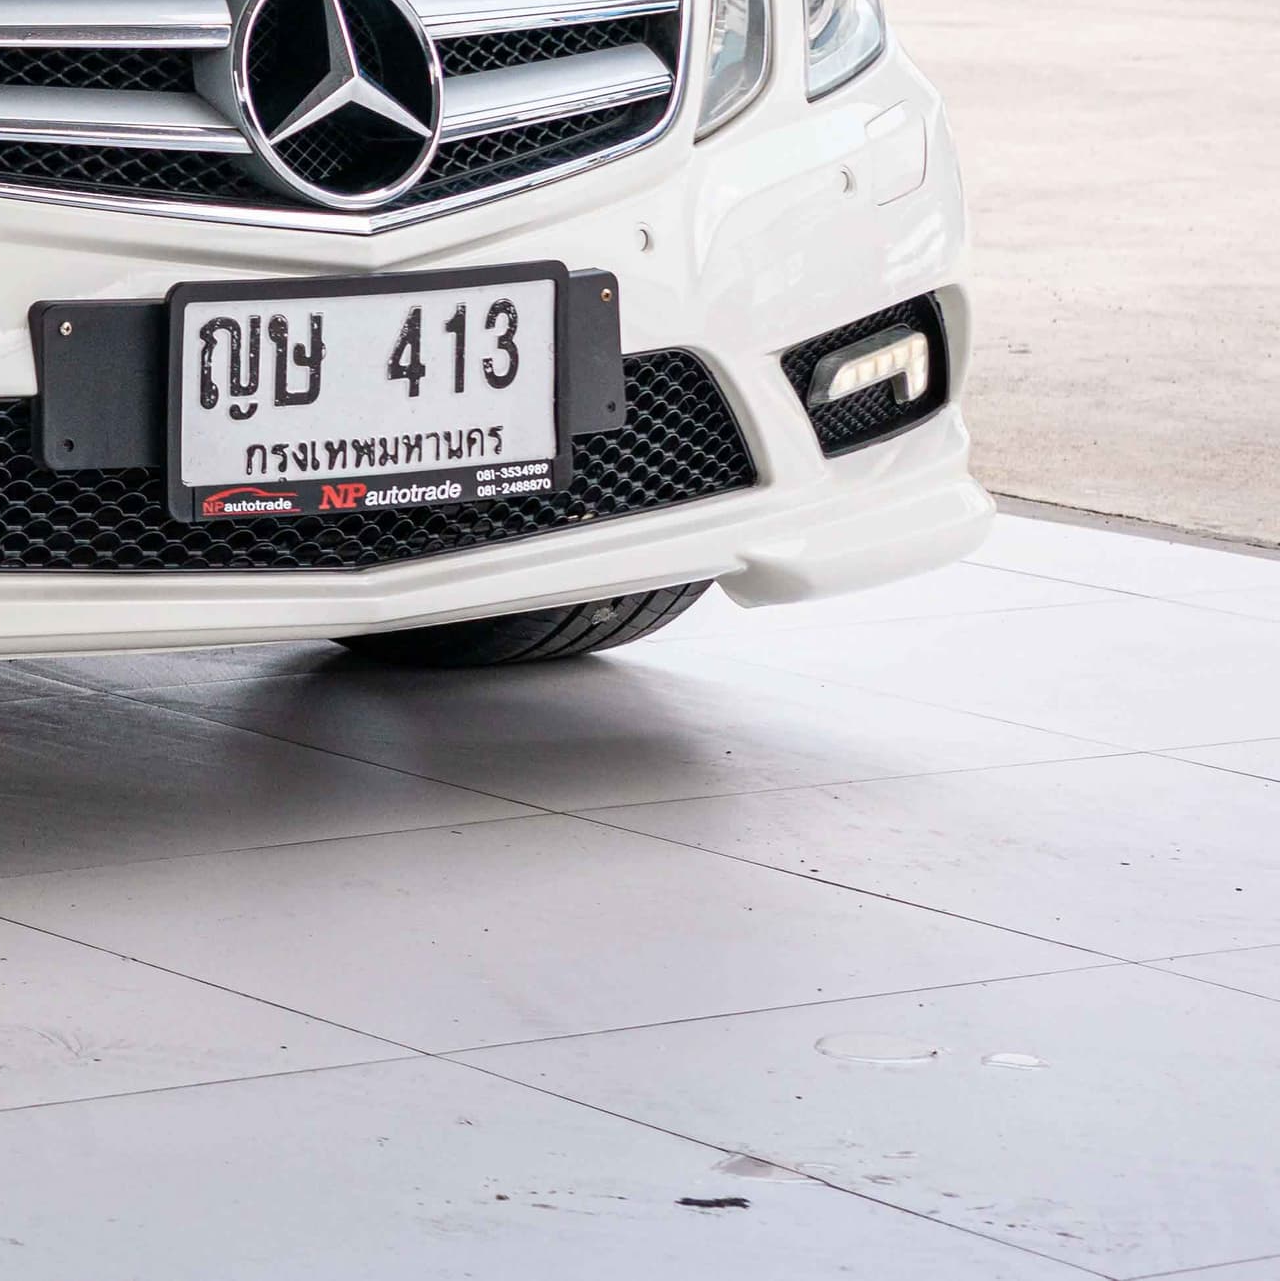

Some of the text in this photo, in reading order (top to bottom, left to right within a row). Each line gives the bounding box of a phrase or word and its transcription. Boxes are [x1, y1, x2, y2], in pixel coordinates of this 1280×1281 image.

[198, 297, 520, 421] ญษ 413
[476, 463, 549, 482] 081-3534989
[477, 478, 552, 497] 081-2488870
